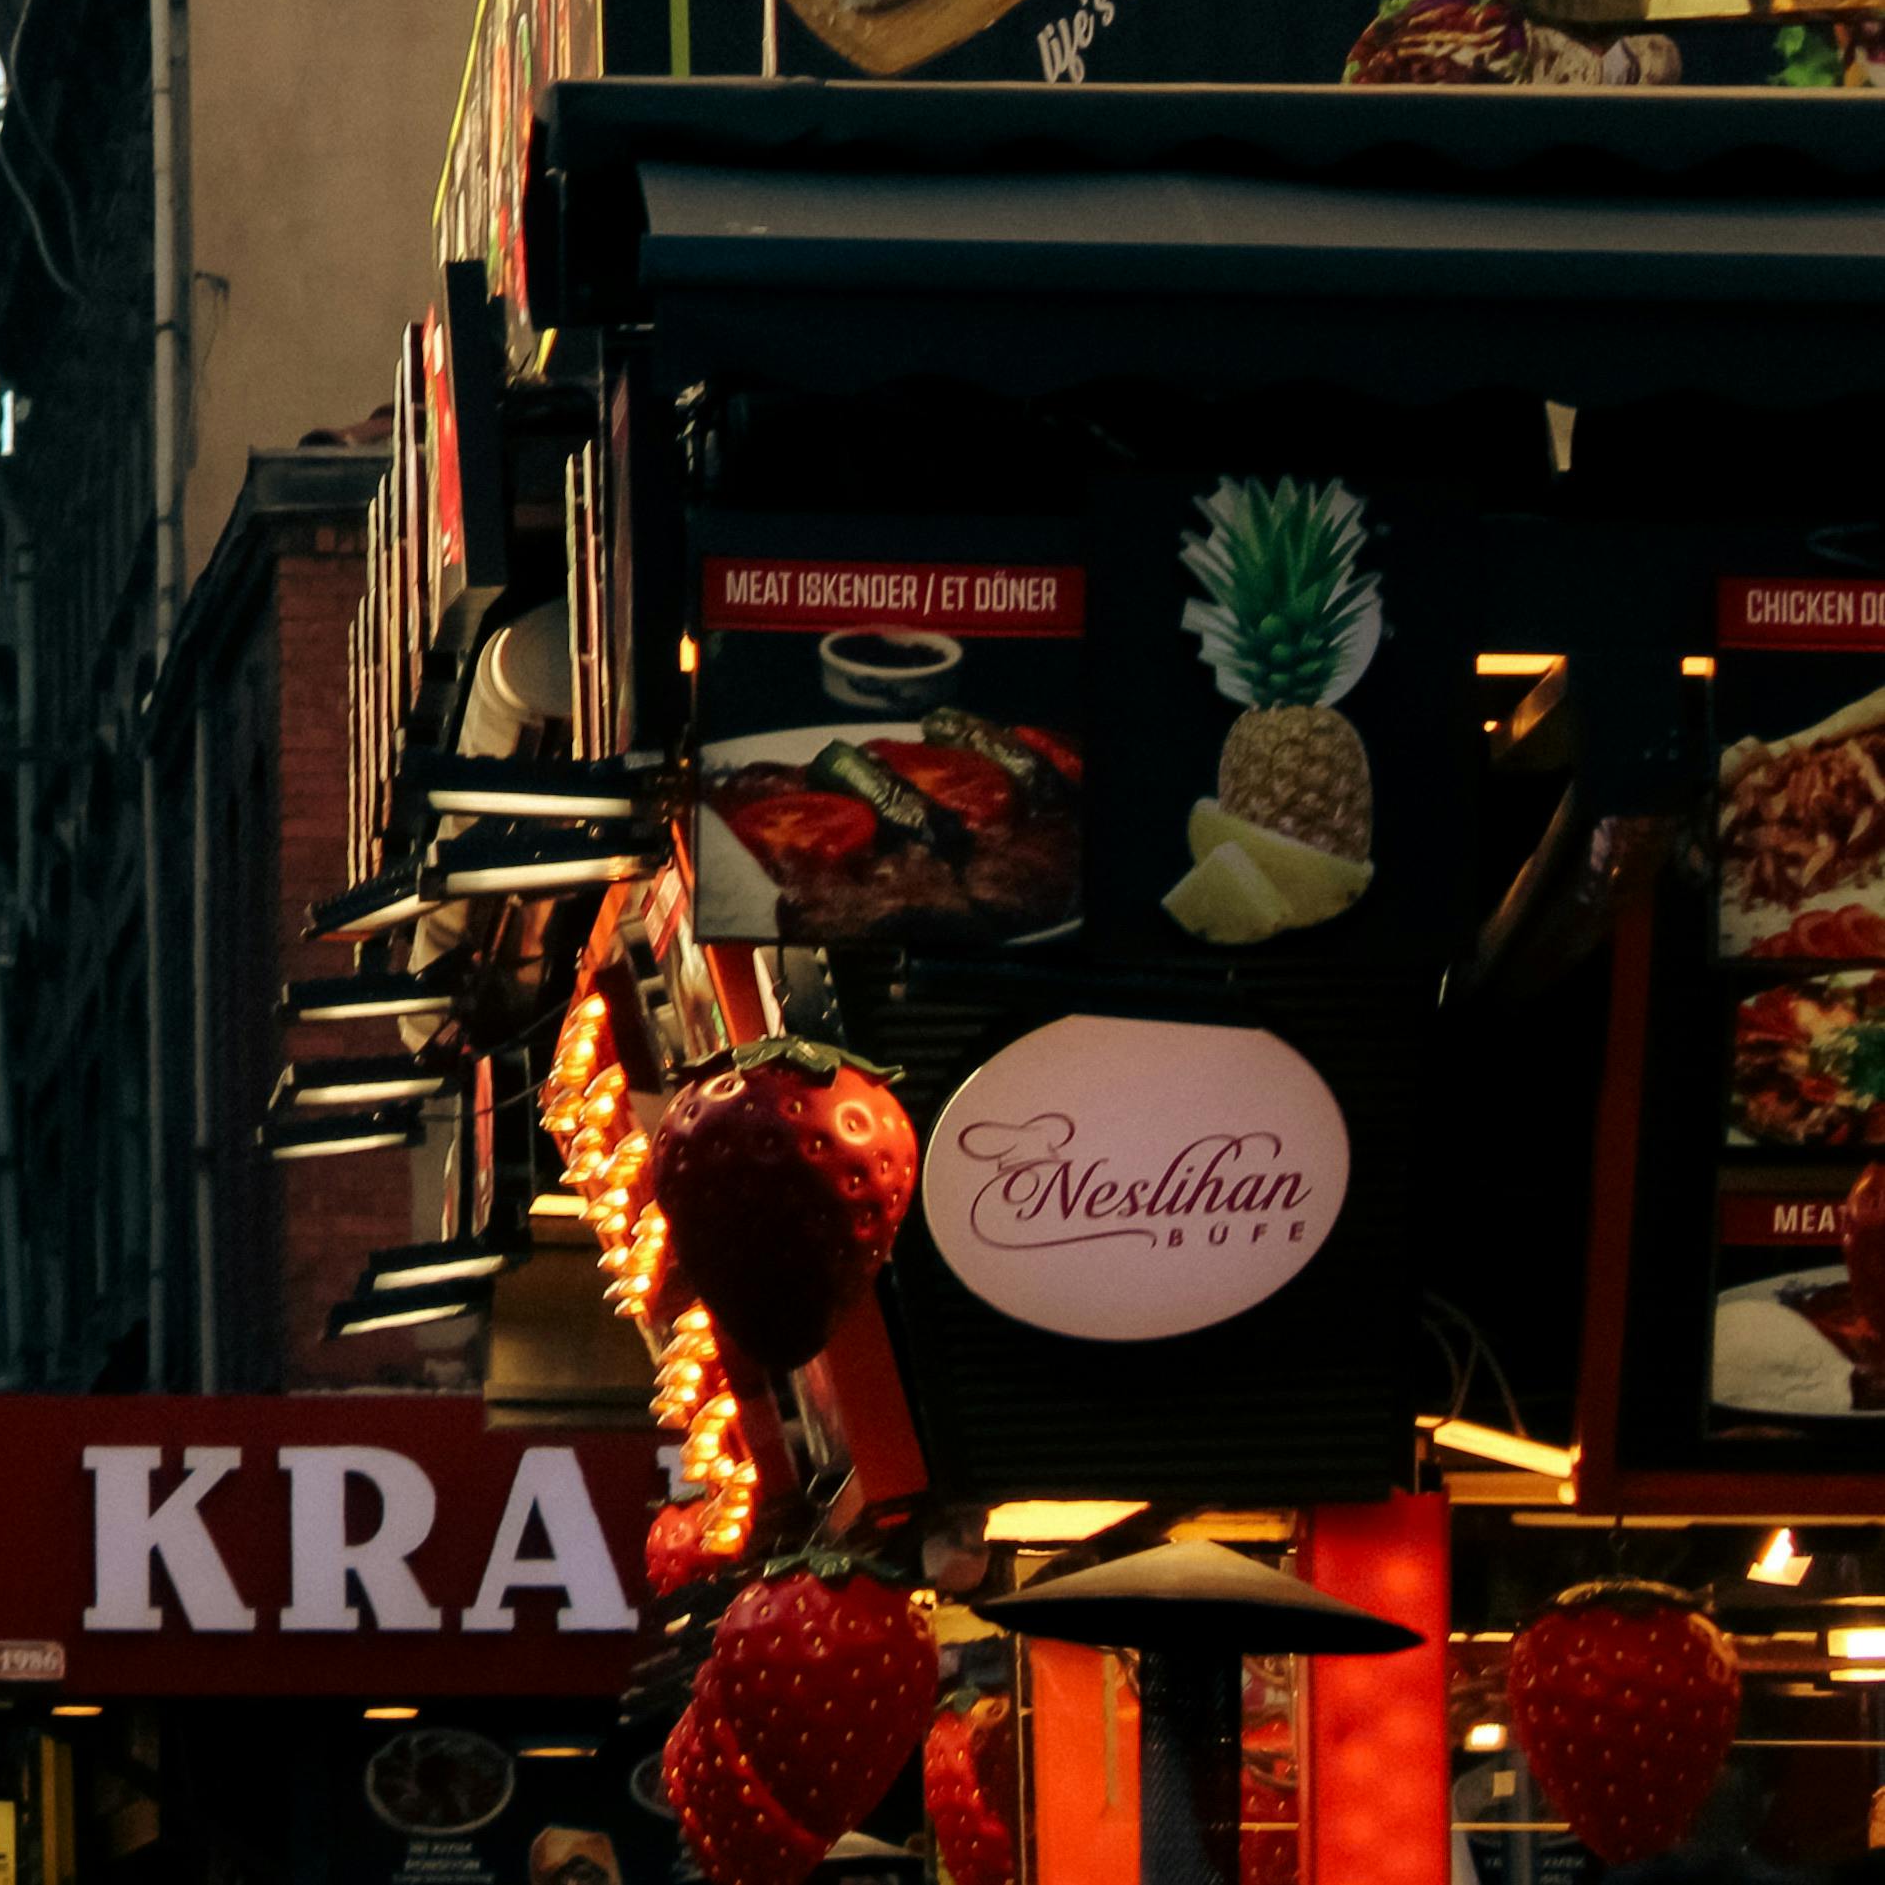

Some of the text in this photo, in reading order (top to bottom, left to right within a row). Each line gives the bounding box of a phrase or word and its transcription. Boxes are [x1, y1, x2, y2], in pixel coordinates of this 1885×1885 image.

[724, 568, 791, 607] MEAT
[921, 576, 934, 617] /
[940, 576, 967, 612] ET
[973, 571, 1059, 613] DÖNER
[1746, 588, 1855, 626] CHICKEN
[1002, 1131, 1312, 1222] Neslihan
[1167, 1219, 1306, 1249] BÜFE
